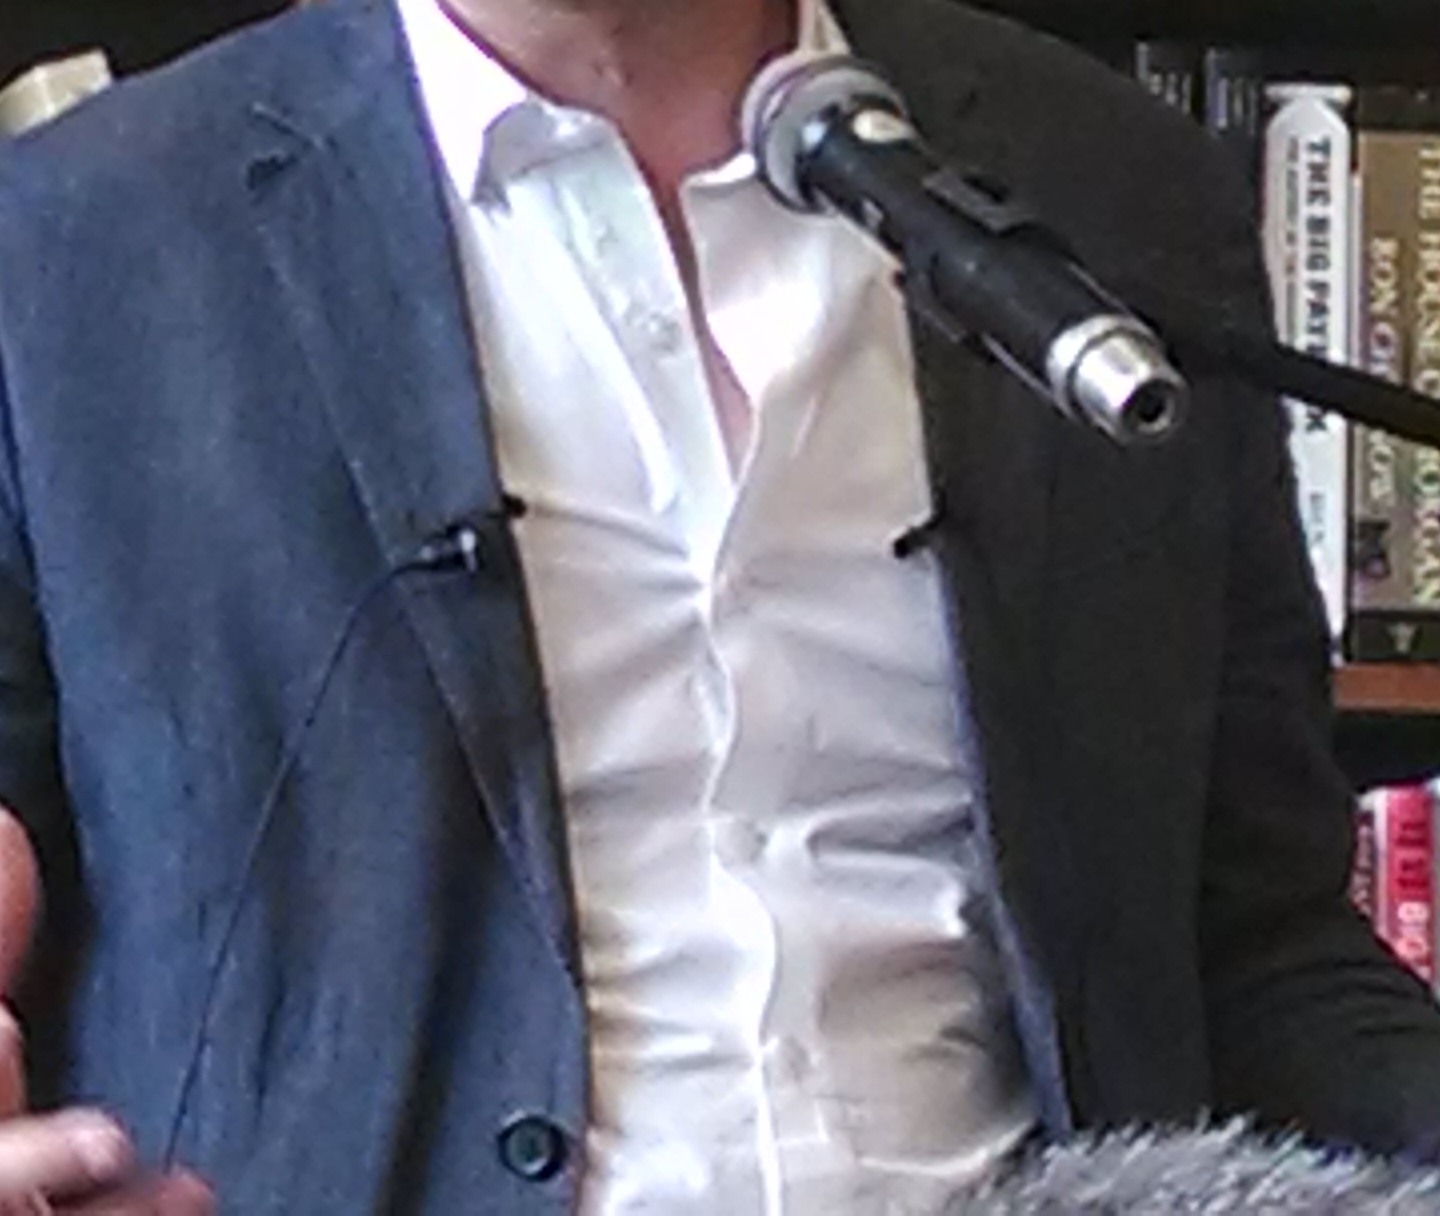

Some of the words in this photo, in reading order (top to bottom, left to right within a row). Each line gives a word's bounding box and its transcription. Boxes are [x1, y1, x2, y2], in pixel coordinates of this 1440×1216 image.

[1306, 137, 1332, 205] THE
[1305, 214, 1332, 269] BIG
[1368, 237, 1398, 313] RON
